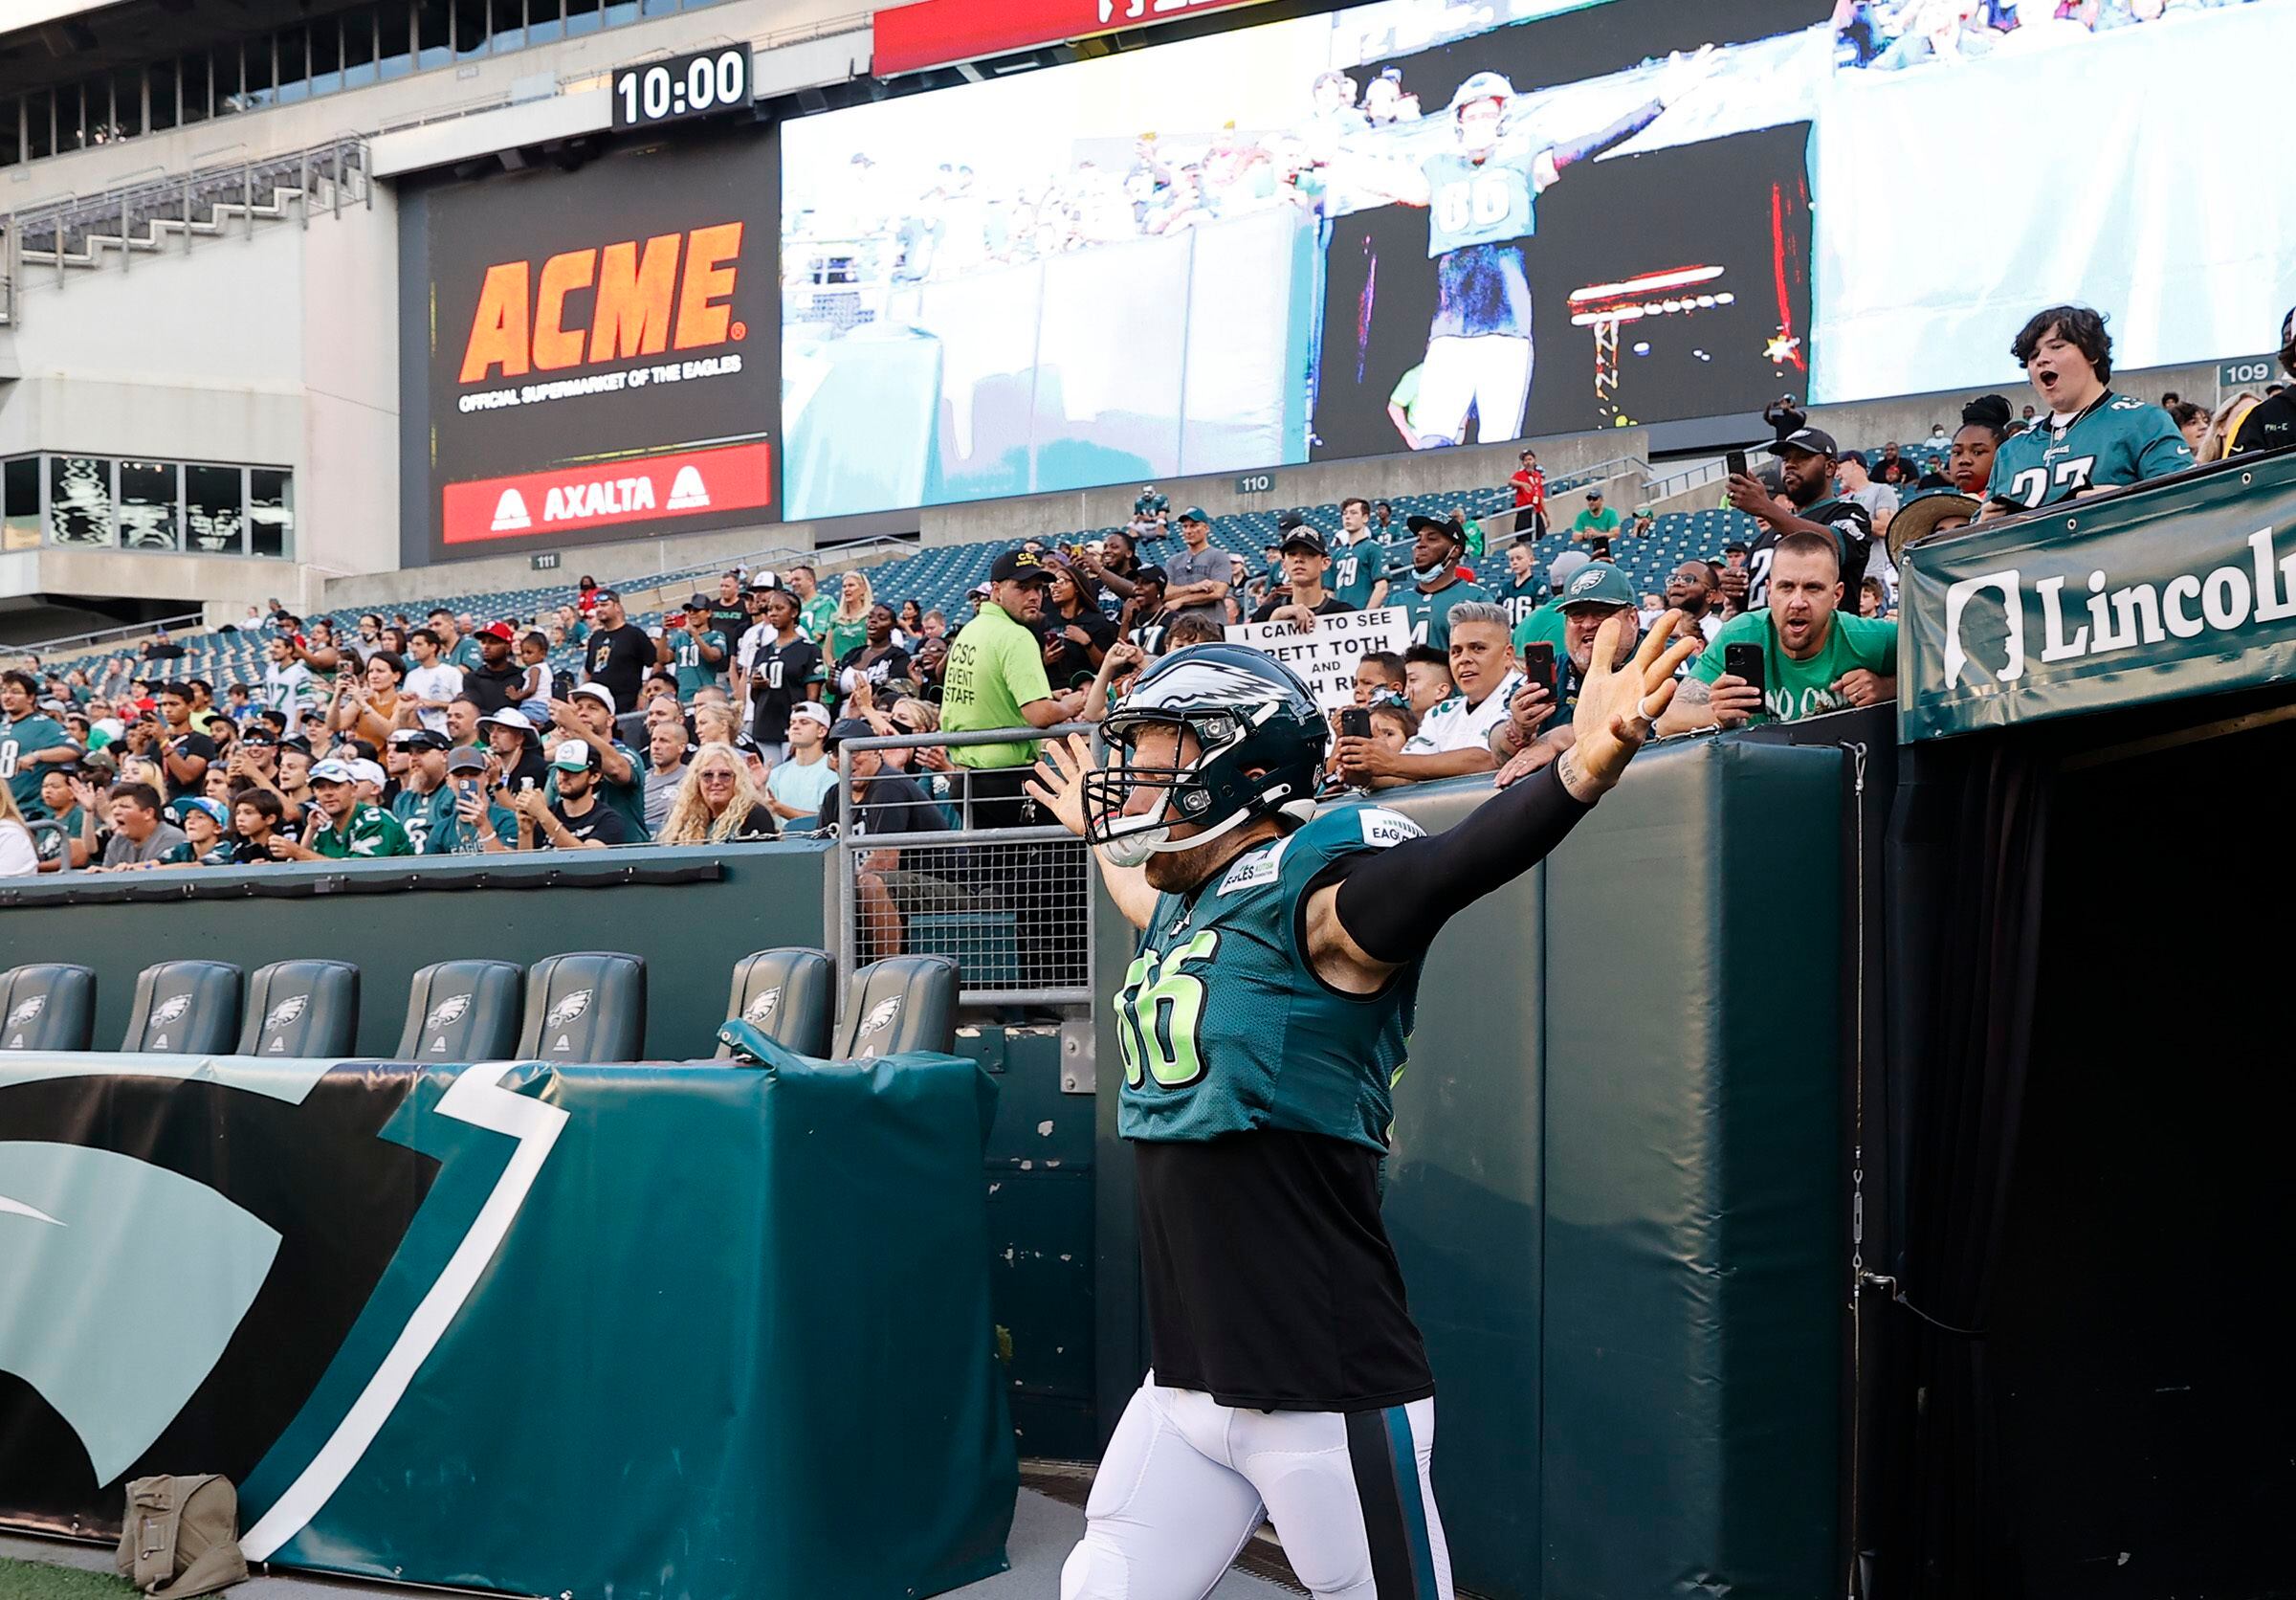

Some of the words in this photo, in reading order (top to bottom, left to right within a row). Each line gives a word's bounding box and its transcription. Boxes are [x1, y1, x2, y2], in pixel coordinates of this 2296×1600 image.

[617, 50, 744, 124] 10:00
[458, 389, 521, 413] OFFICIAL
[521, 373, 628, 404] SUPERMARKET
[628, 368, 651, 388] OF
[651, 362, 683, 384] THE
[682, 354, 743, 380] EAGLES
[2226, 363, 2269, 384] 109
[1242, 476, 1269, 492] 110
[542, 475, 656, 522] AXALTA
[537, 555, 556, 568] 111
[1336, 557, 1358, 590] 29
[1244, 628, 1250, 641] I
[1261, 623, 1315, 639] CAM
[1323, 615, 1349, 632] TO
[1357, 611, 1393, 628] SEE
[950, 642, 977, 667] CSC
[1264, 644, 1318, 662] RETT
[1329, 634, 1389, 656] TOTH
[947, 667, 974, 688] EVENT
[1311, 660, 1341, 674] AND
[943, 686, 976, 706] STAFF
